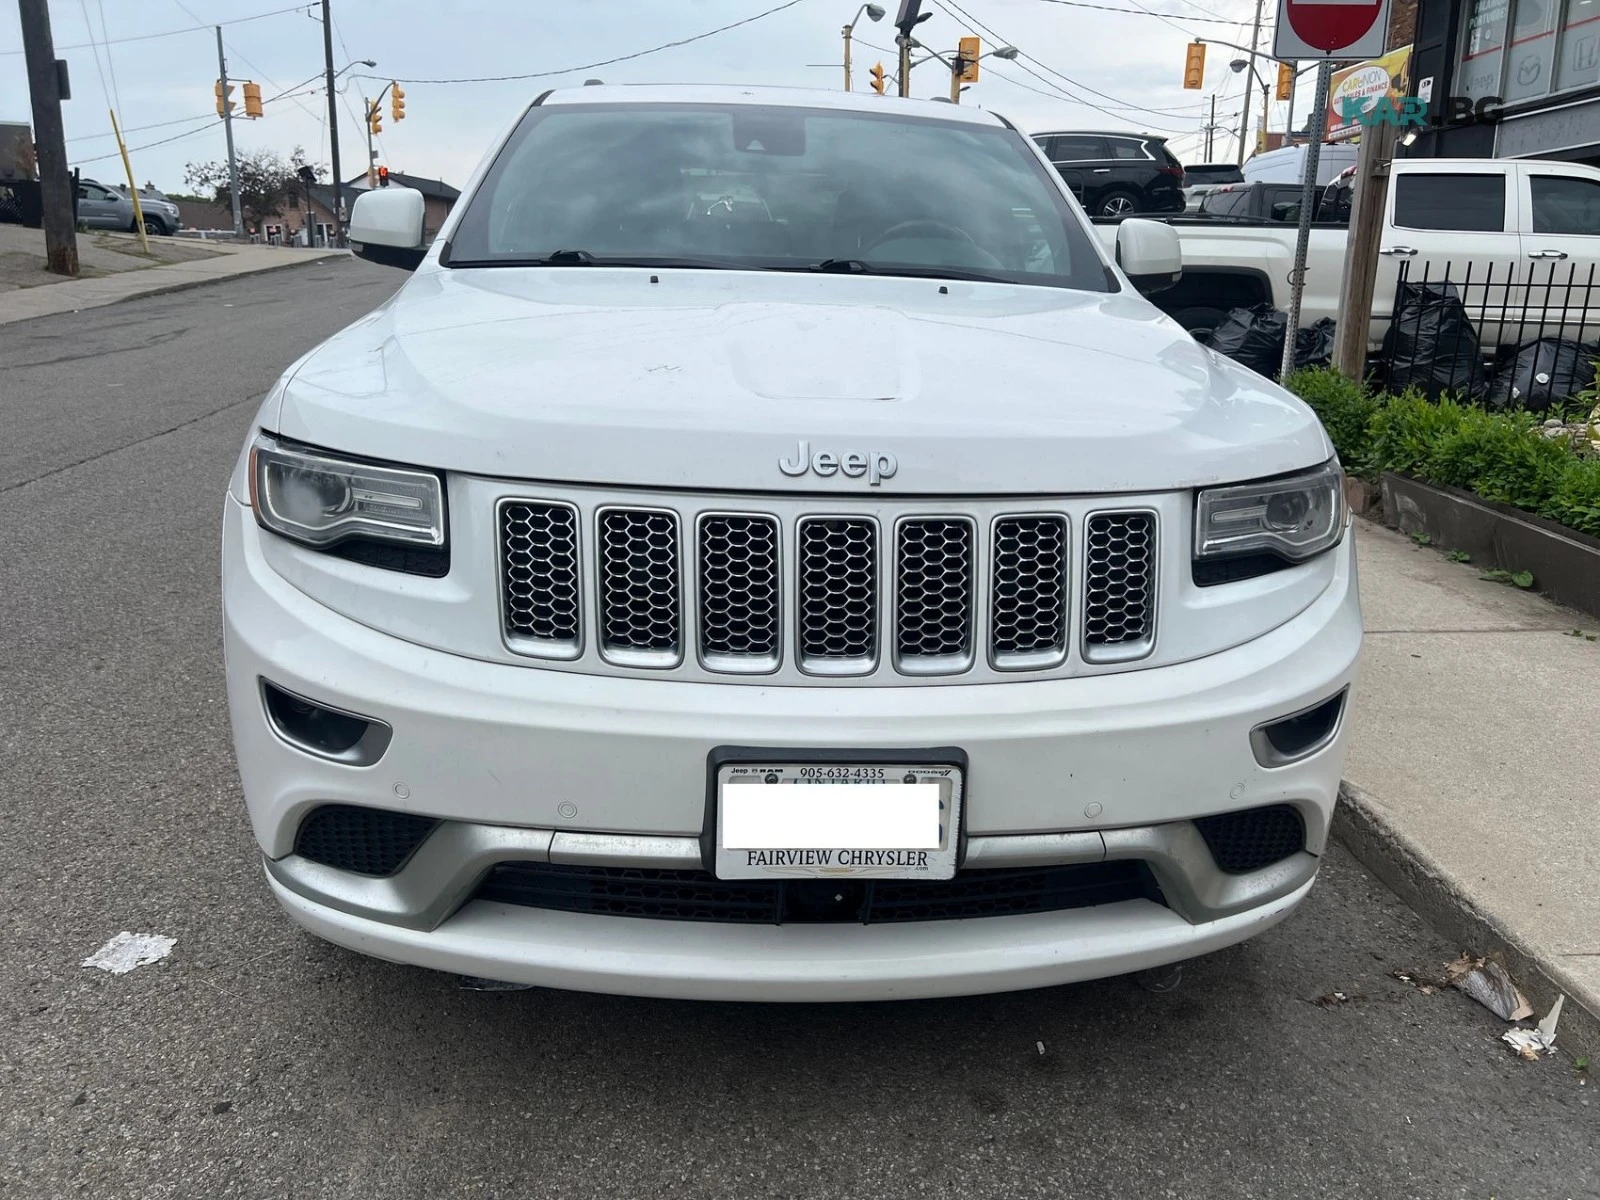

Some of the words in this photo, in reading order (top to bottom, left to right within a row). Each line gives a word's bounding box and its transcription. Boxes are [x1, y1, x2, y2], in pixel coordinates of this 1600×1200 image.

[779, 440, 897, 486] Jeep
[800, 768, 884, 778] 905-632-4335
[747, 850, 831, 866] FAIRVIEW
[838, 850, 927, 866] CHRYSLER
